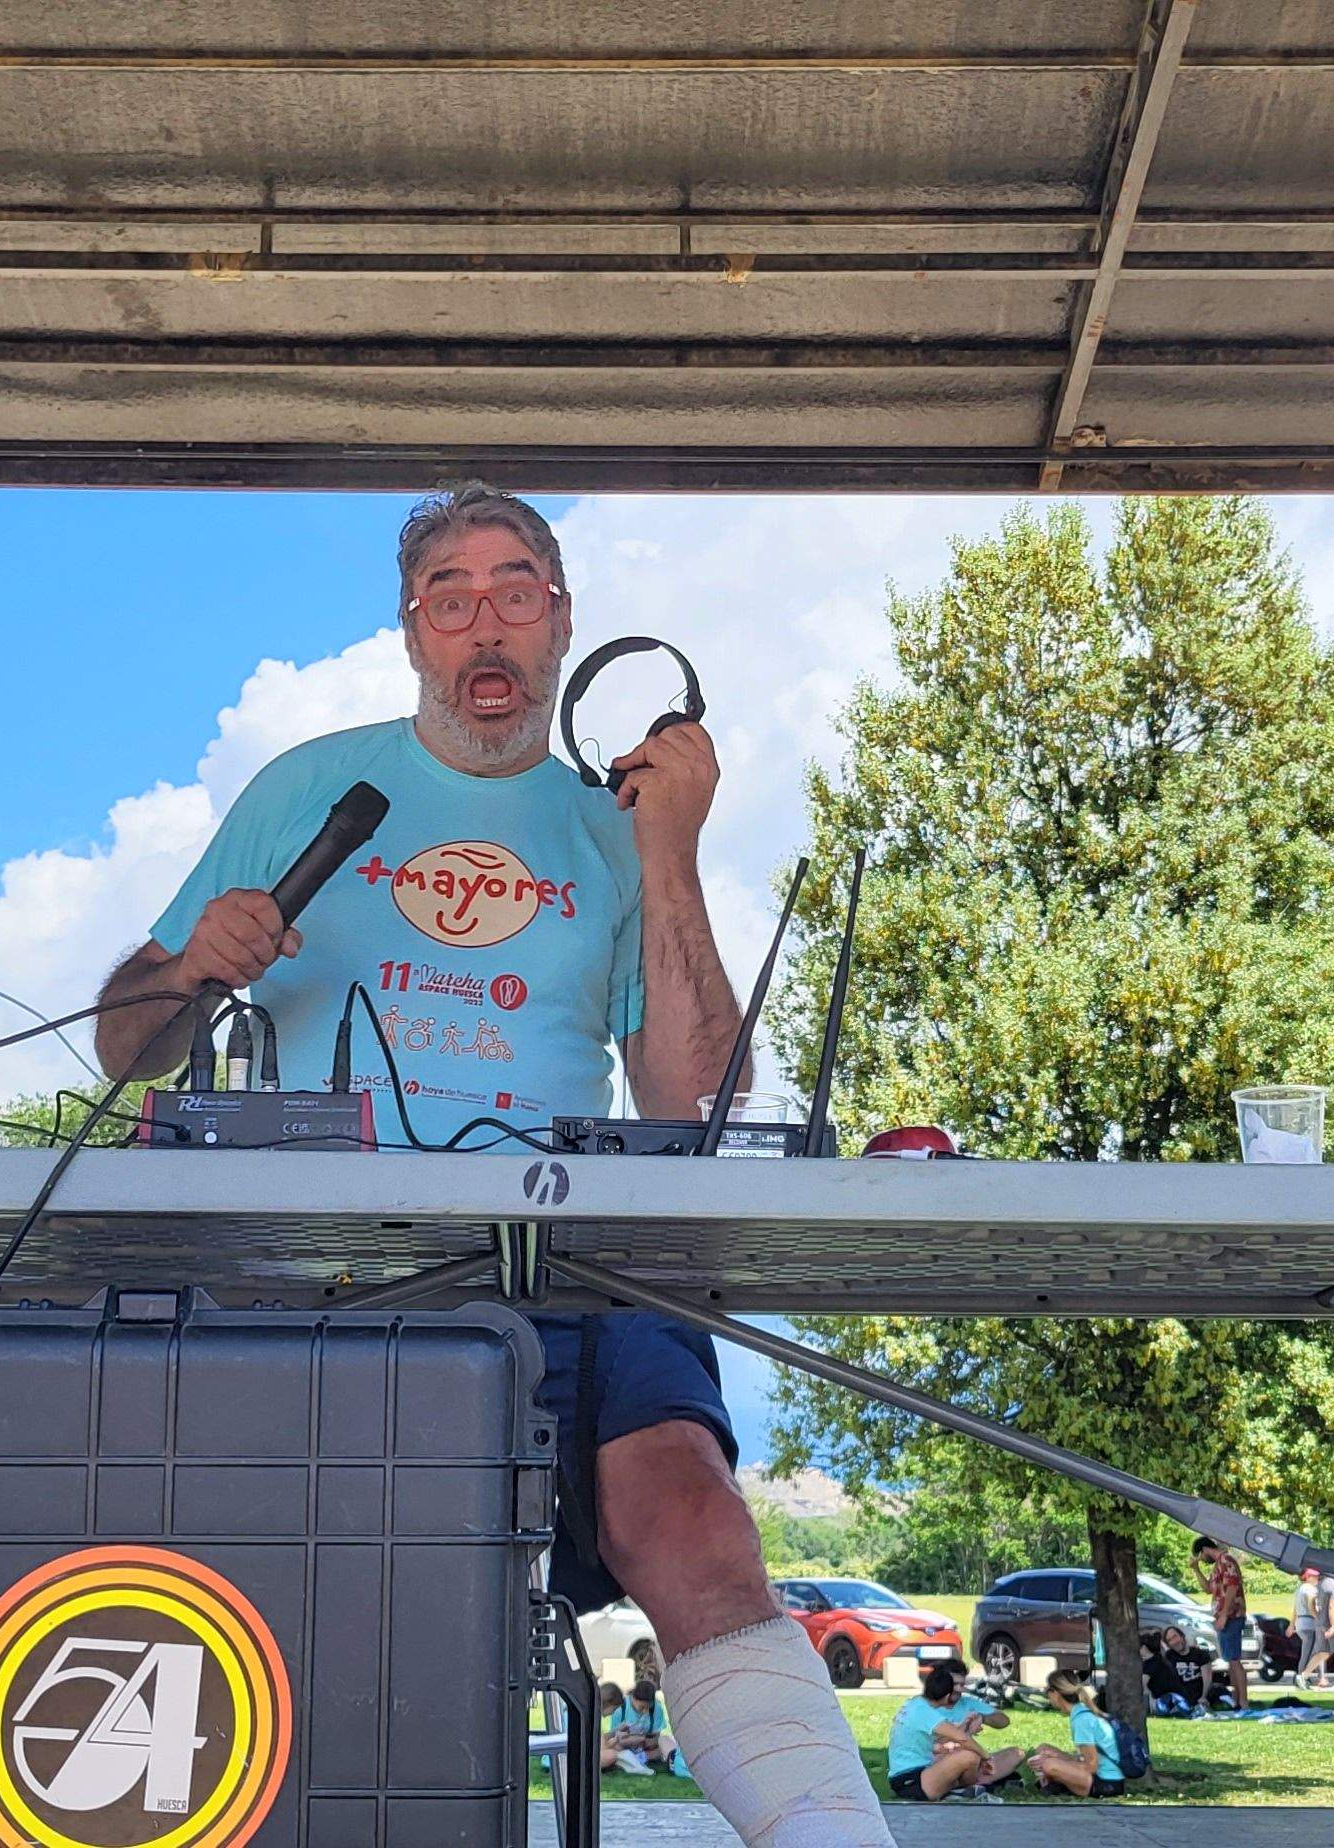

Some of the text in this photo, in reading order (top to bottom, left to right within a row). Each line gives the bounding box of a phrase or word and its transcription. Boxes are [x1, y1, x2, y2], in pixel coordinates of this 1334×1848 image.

[421, 963, 486, 990] Marcha
[419, 983, 450, 995] ASPACE
[12, 1637, 208, 1814] 54
[157, 1798, 187, 1811] HUESCA
